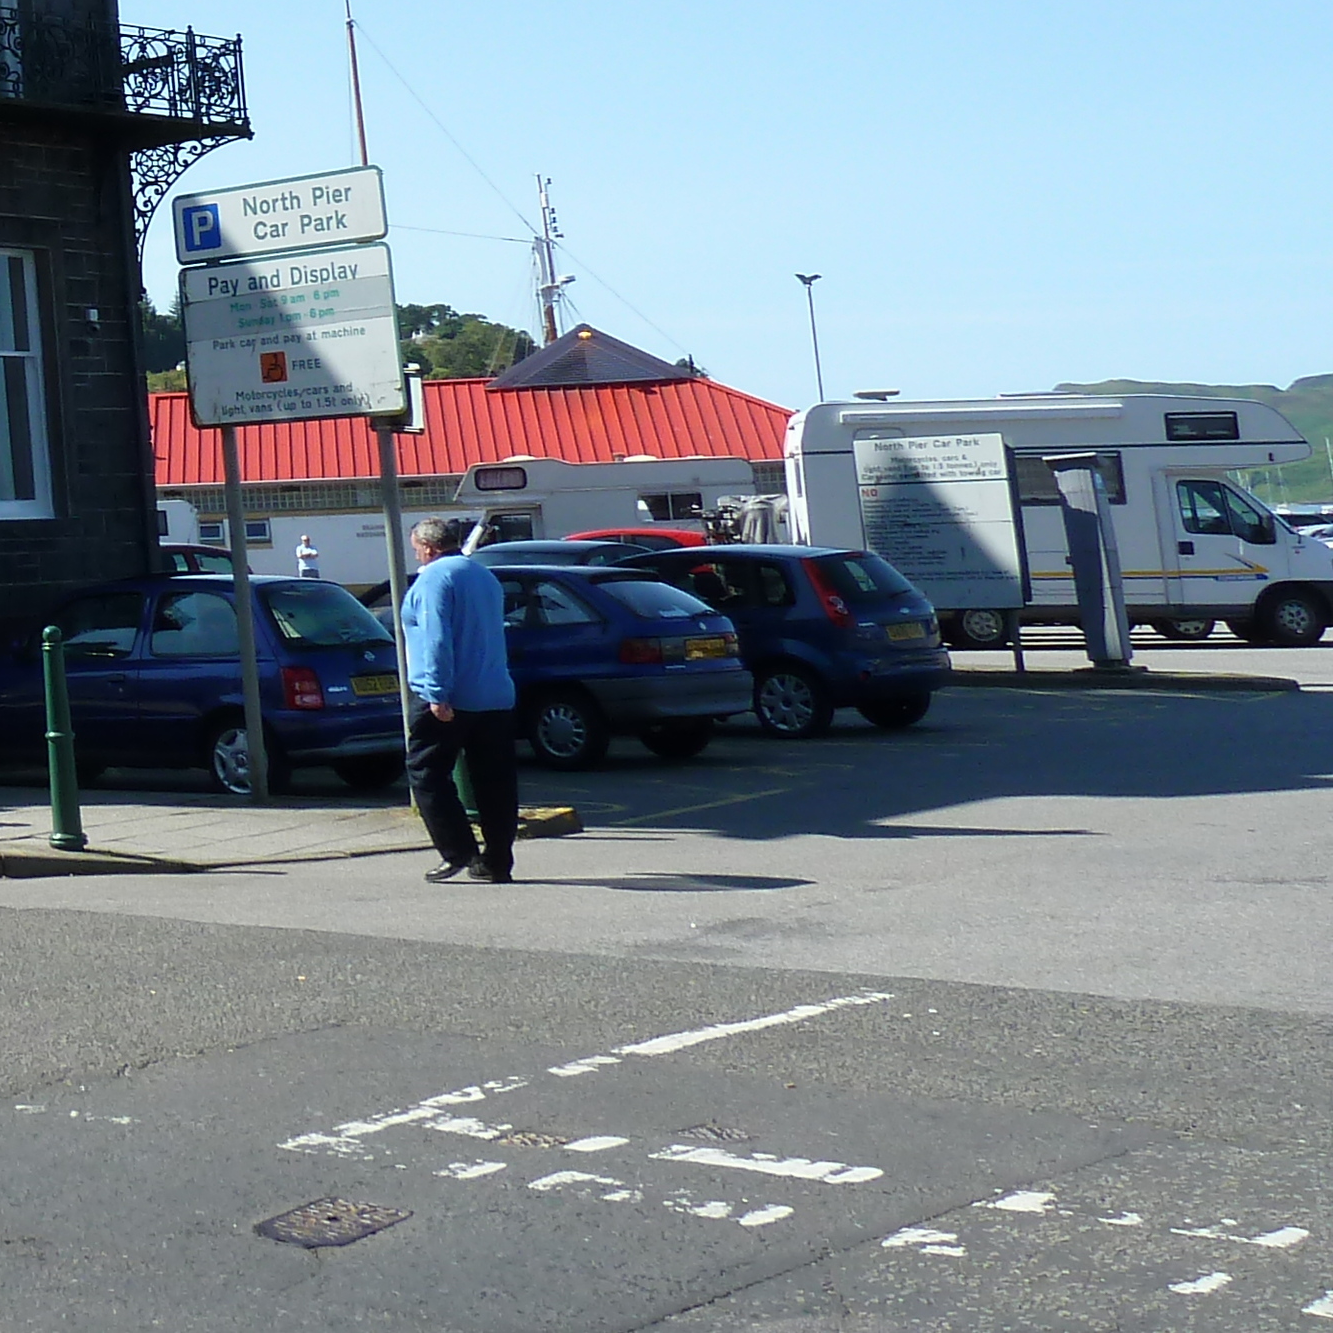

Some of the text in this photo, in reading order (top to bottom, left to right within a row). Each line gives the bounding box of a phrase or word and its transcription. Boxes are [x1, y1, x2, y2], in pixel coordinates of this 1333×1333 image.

[242, 185, 352, 216] North Pier
[191, 210, 213, 246] P
[253, 210, 348, 240] Car Park
[208, 262, 358, 296] Pay and Display
[230, 302, 252, 314] Mon
[238, 313, 275, 329] Sunday
[212, 326, 366, 350] Park car and pay at machine
[291, 358, 321, 371] FREE
[333, 382, 354, 393] and
[249, 403, 273, 413] vans
[301, 400, 313, 409] to
[874, 438, 981, 452] North Pier Car Park
